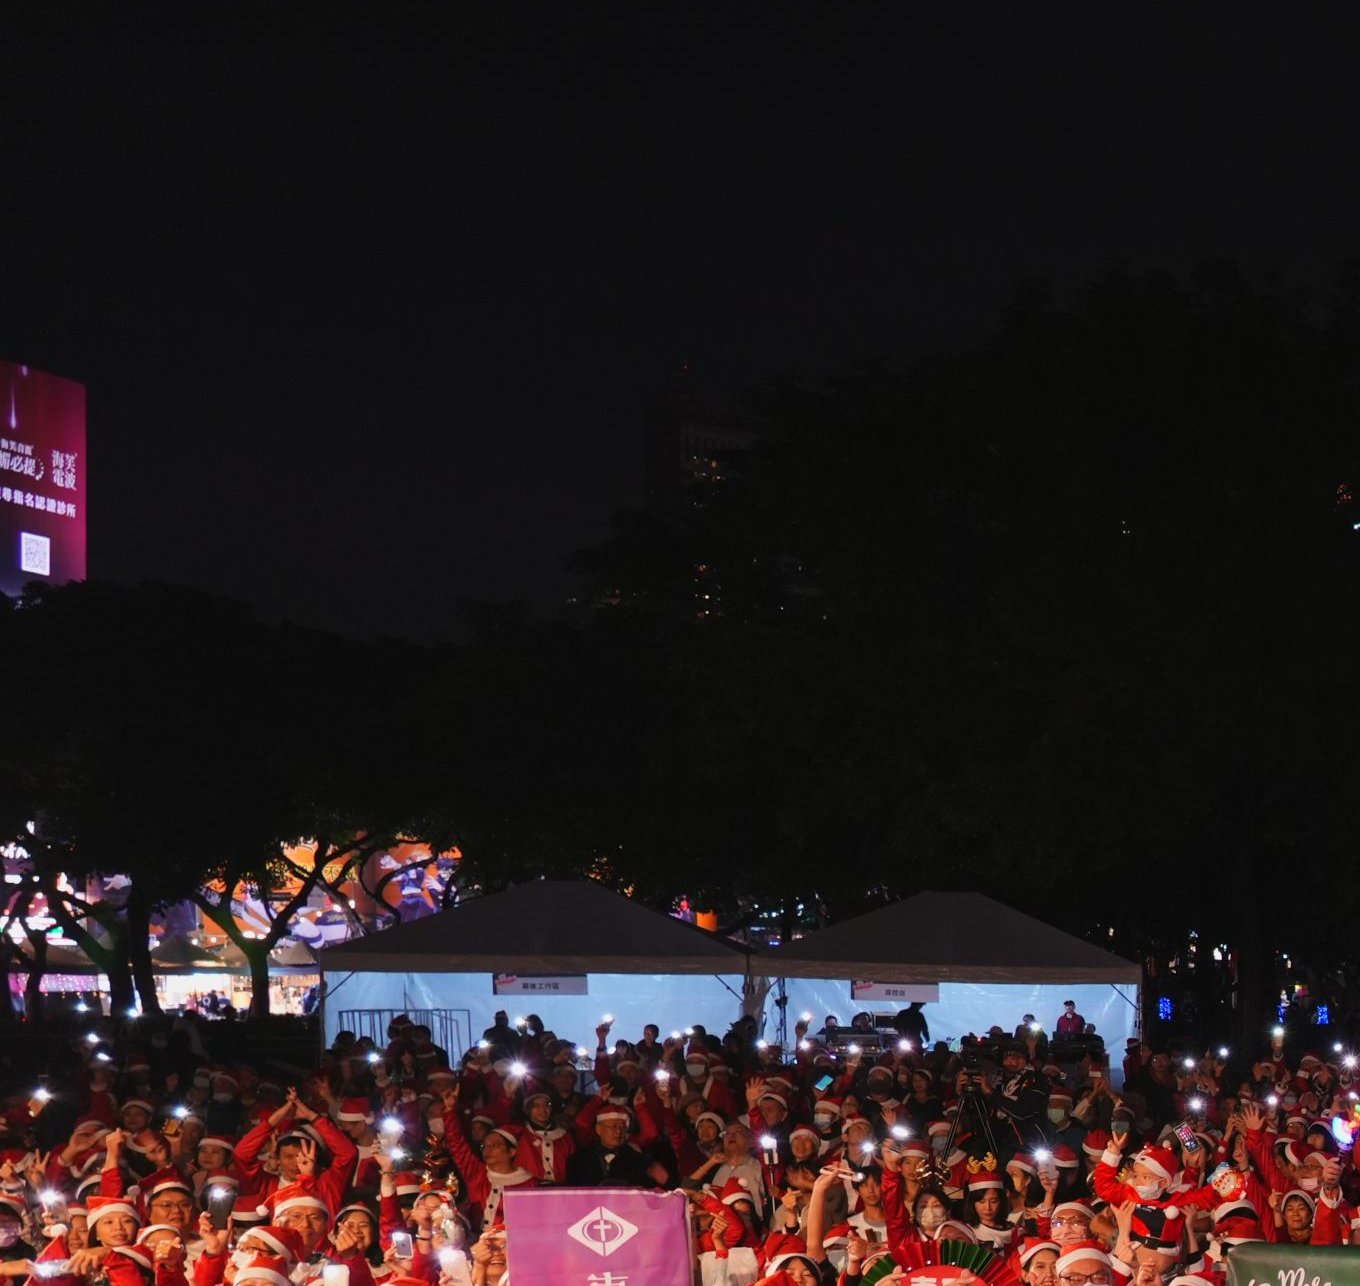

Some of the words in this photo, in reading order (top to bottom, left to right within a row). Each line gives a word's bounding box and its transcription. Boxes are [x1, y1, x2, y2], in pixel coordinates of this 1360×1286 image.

[0, 486, 76, 518] 尋指名認證診所
